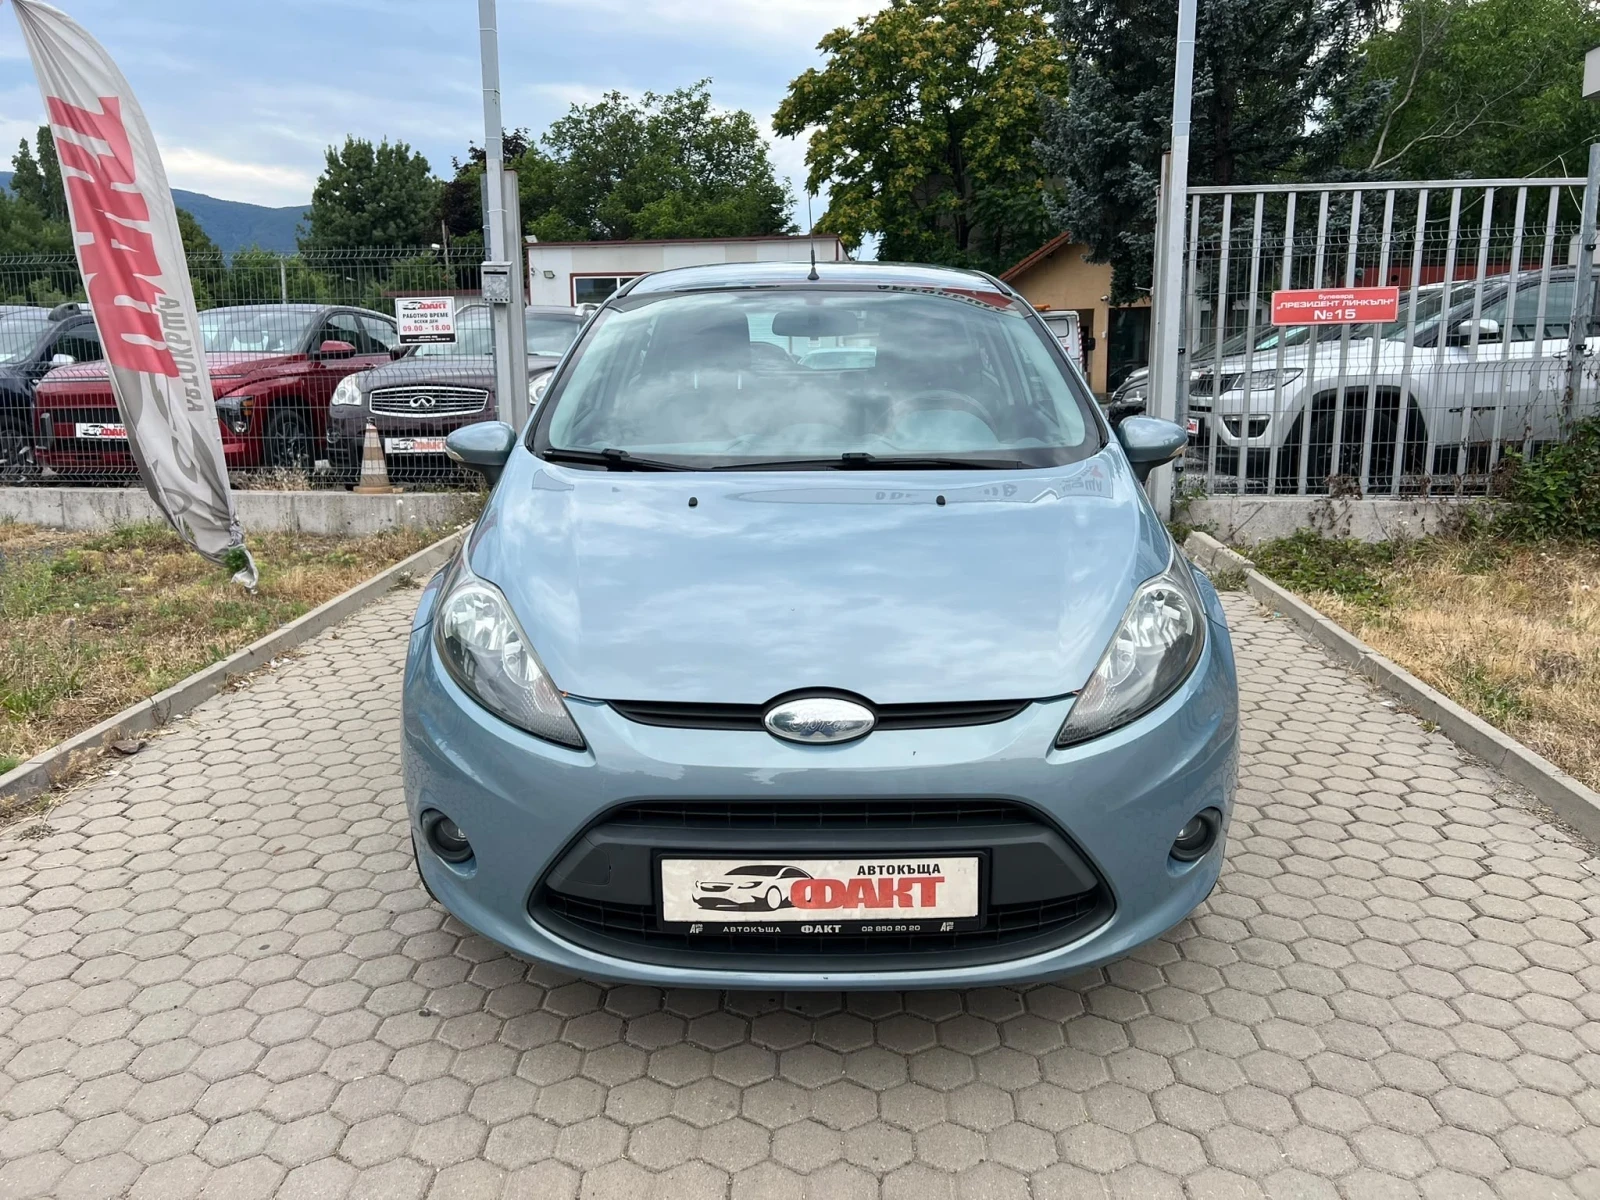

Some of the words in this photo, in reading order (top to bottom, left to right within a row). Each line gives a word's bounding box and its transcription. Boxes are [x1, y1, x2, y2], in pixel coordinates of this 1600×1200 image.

[857, 863, 942, 876] АВТОКЪЩА
[790, 876, 946, 910] ФАКТ
[800, 924, 842, 934] ФАКТ
